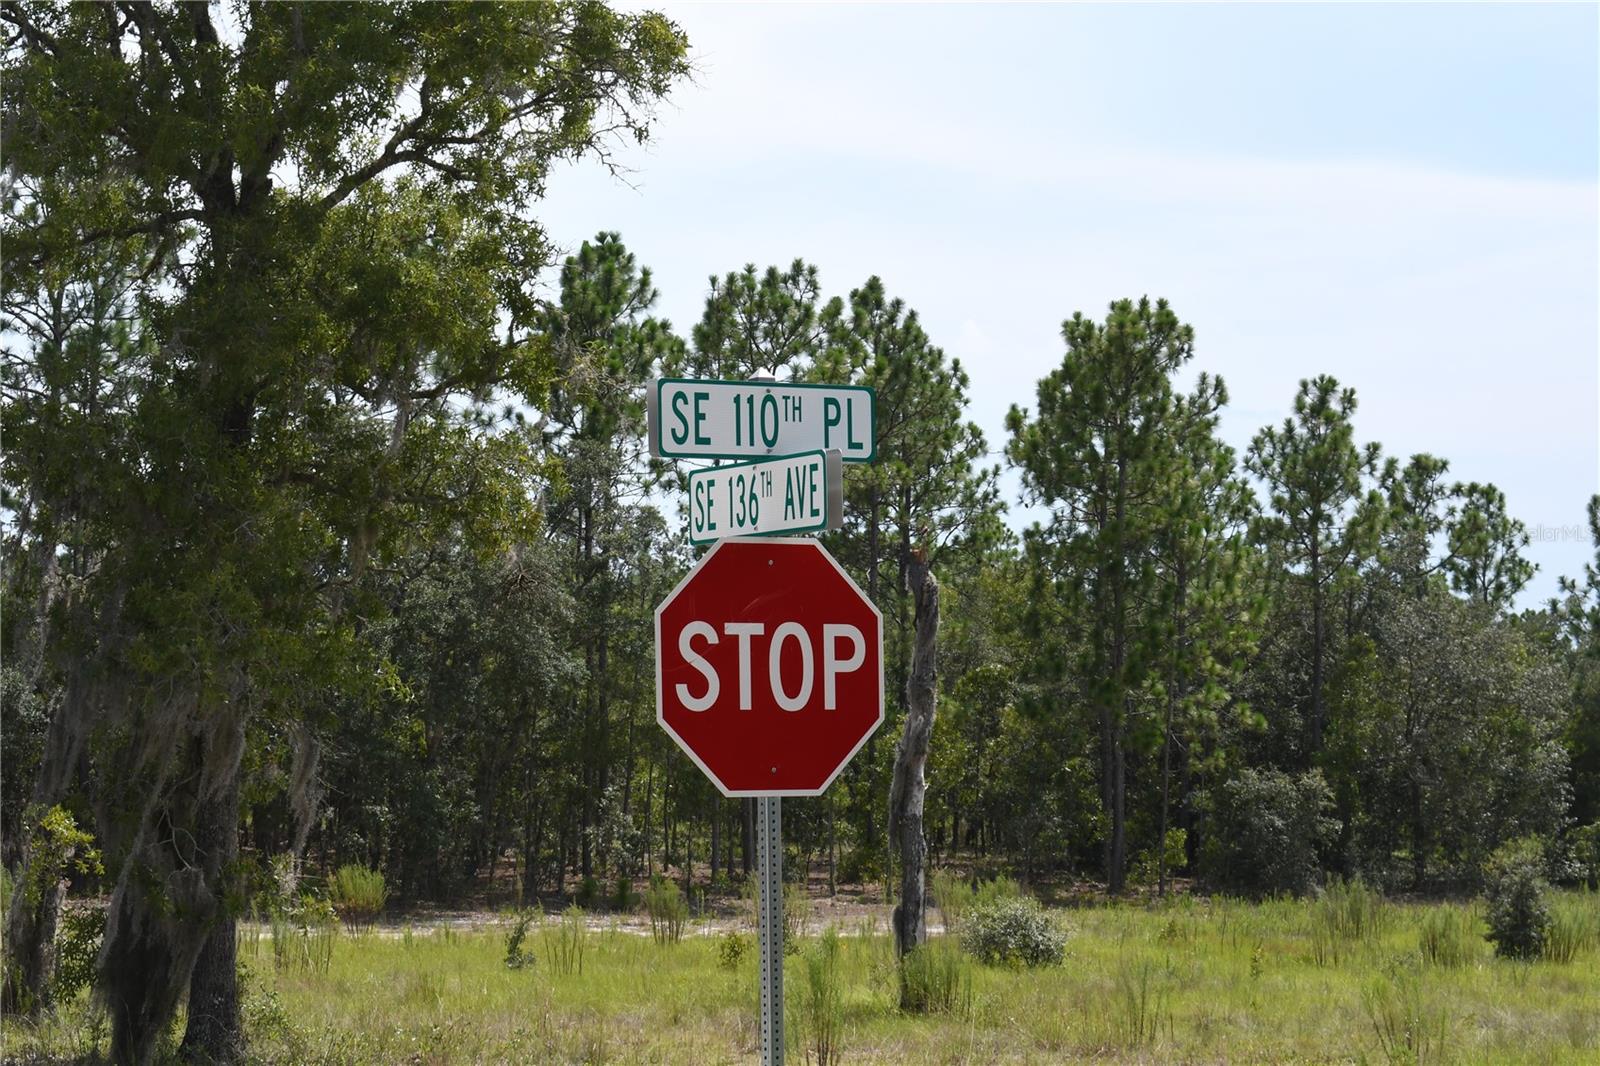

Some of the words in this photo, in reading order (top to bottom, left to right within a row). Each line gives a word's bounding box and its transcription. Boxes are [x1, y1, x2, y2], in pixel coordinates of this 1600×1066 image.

[671, 391, 711, 445] SE
[733, 393, 802, 448] 110TH
[824, 396, 864, 449] PL
[695, 478, 717, 533] SE
[729, 470, 773, 528] 136TH
[784, 463, 820, 521] AVE
[675, 620, 866, 712] STOP
